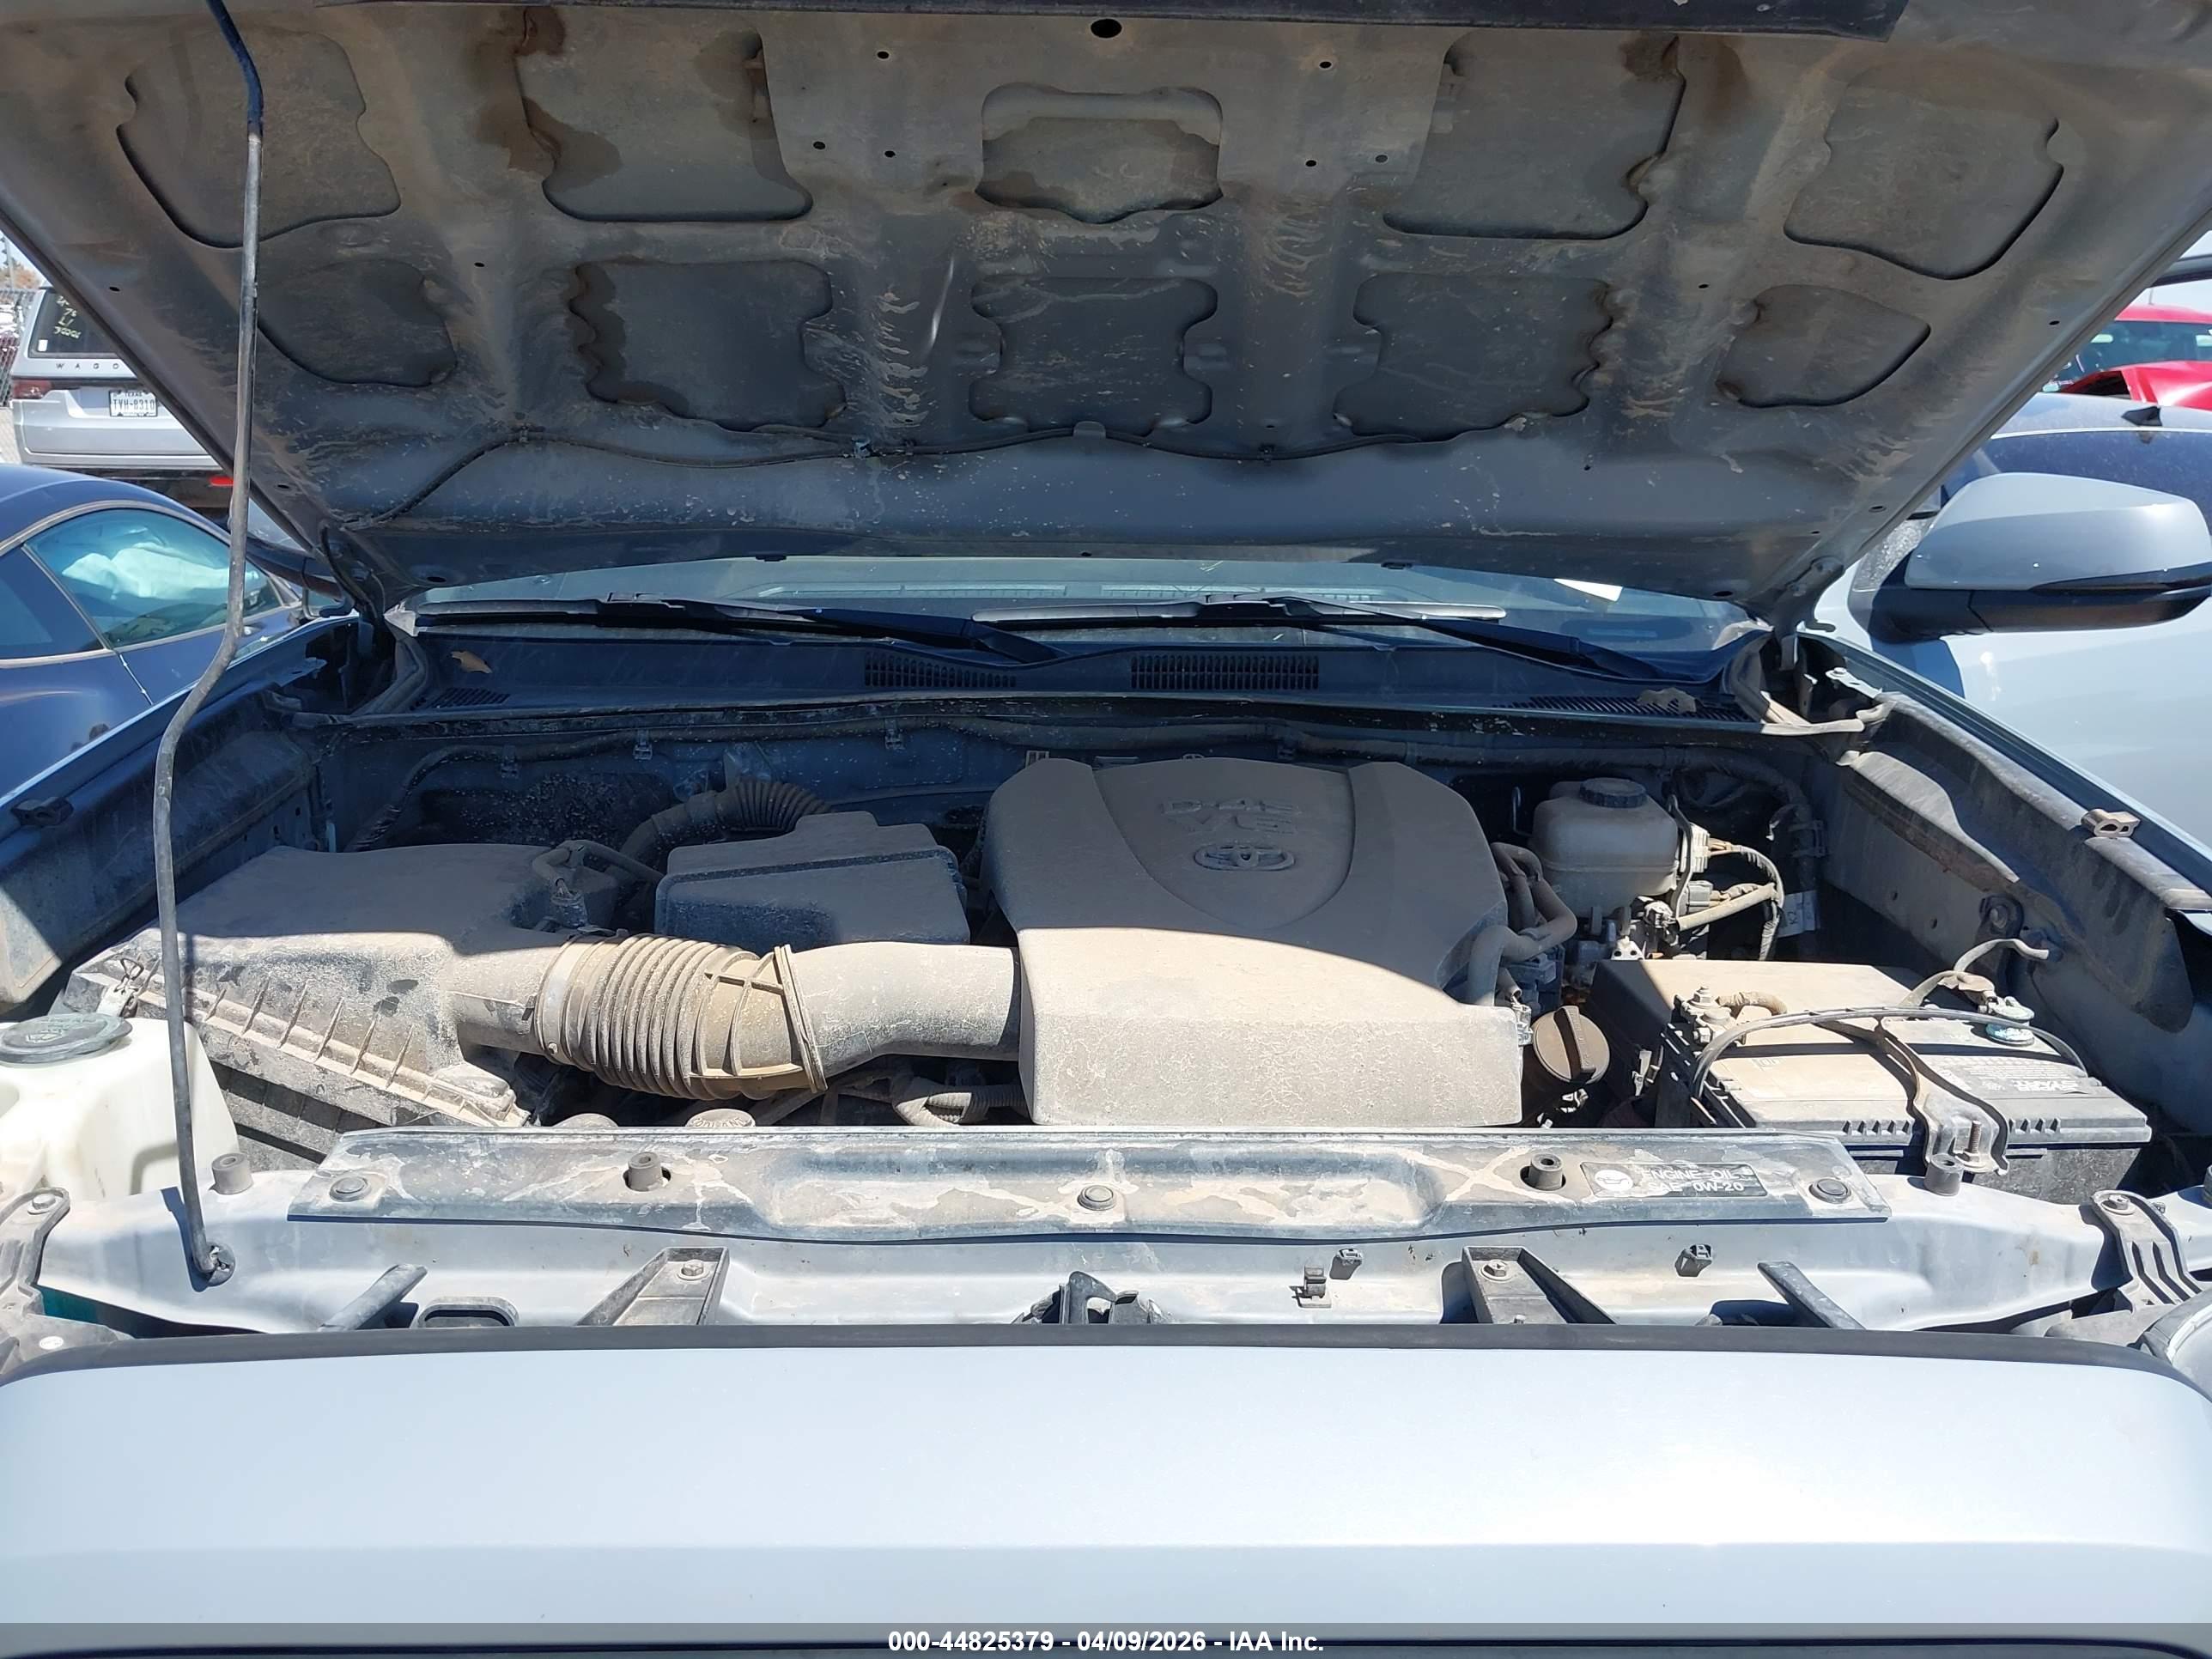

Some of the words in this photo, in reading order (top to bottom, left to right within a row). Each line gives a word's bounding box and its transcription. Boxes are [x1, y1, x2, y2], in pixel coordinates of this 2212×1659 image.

[1642, 1169, 1699, 1180] ENGINE
[1711, 1169, 1740, 1180] OIL
[1648, 1182, 1683, 1192] SAE
[1692, 1182, 1745, 1192] 0W-20
